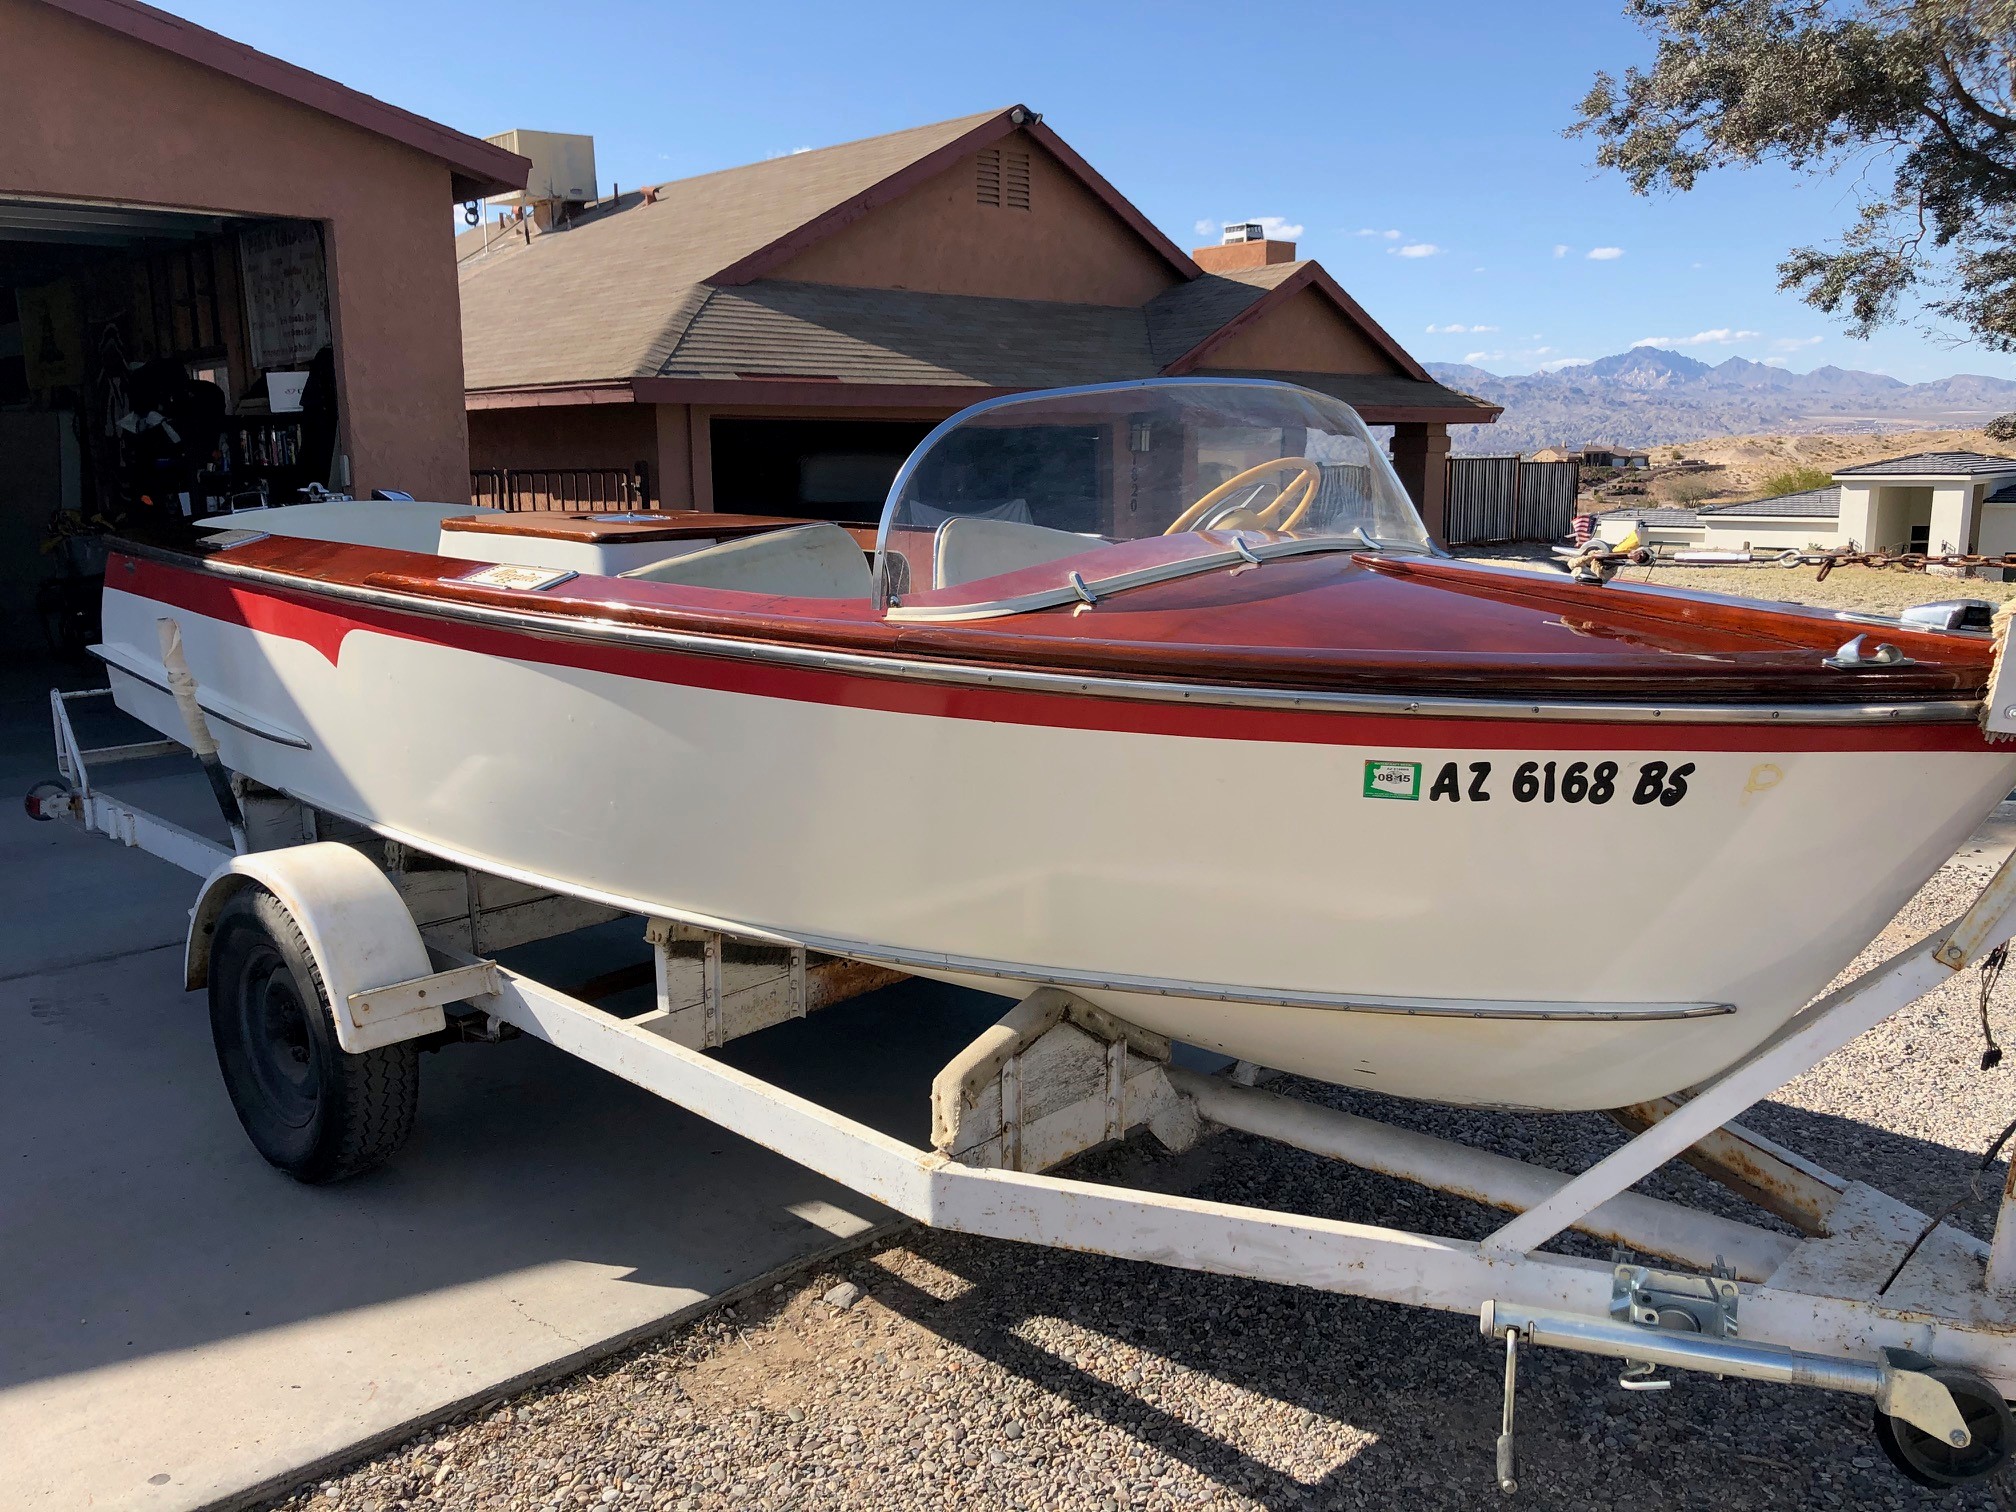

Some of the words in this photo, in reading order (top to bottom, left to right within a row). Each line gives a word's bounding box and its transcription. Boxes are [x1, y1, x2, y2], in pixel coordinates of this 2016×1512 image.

[1430, 761, 1492, 802] AZ
[1512, 760, 1619, 805] 6168
[1632, 760, 1696, 807] BS
